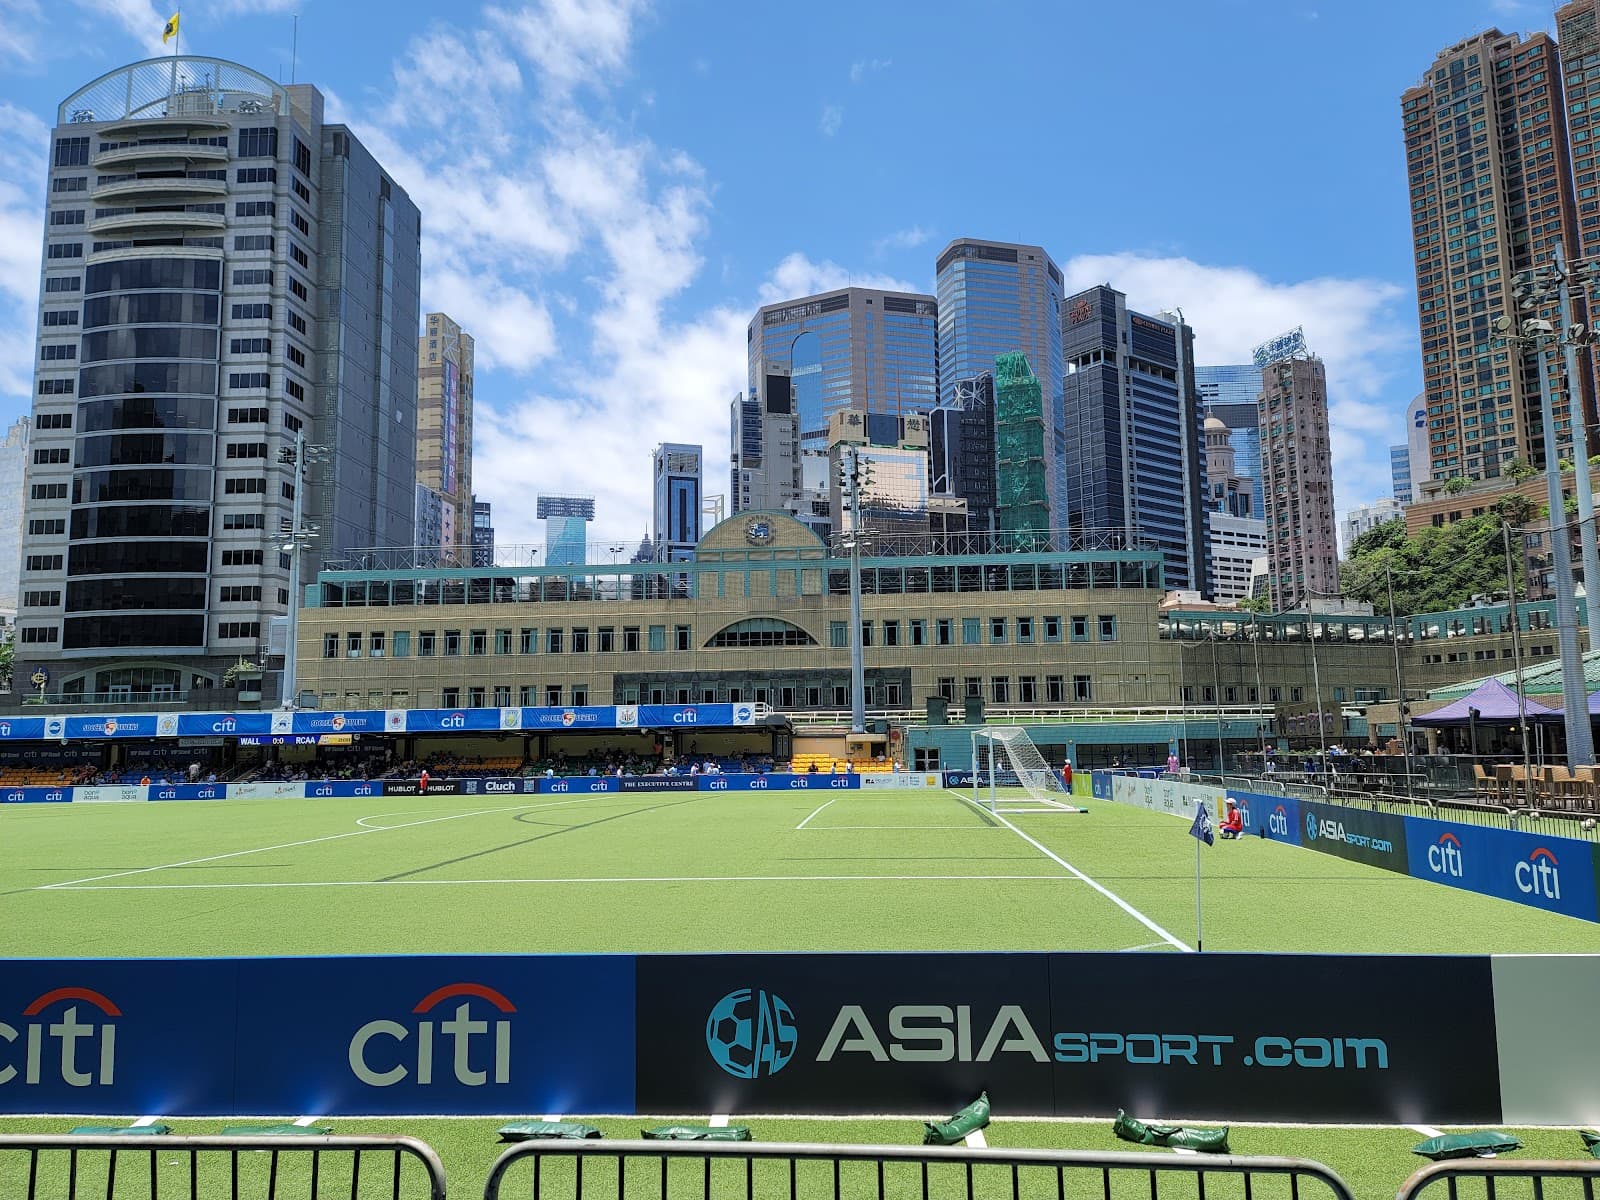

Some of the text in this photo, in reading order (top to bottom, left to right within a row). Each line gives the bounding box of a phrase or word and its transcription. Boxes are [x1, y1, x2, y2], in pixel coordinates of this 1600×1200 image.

[441, 715, 465, 728] citi
[673, 711, 698, 723] citi
[212, 720, 236, 732] citi
[240, 737, 260, 745] WALL
[295, 736, 316, 744] RCAA
[485, 781, 516, 791] Cluch
[551, 781, 569, 792] citi
[590, 780, 608, 791] citi
[709, 778, 728, 790] citi
[749, 778, 768, 789] citi
[790, 777, 808, 788] citi
[831, 776, 849, 788] citi
[158, 788, 176, 799] citi
[198, 787, 215, 798] citi
[315, 785, 333, 796] citi
[354, 784, 372, 795] citi
[427, 784, 456, 792] HUBLOT
[7, 791, 25, 802] citi
[45, 791, 63, 801] citi
[1238, 804, 1250, 827] iti
[1269, 810, 1288, 836] citi
[1428, 840, 1463, 877] citi
[1514, 856, 1561, 900] citi
[348, 1000, 511, 1087] citi
